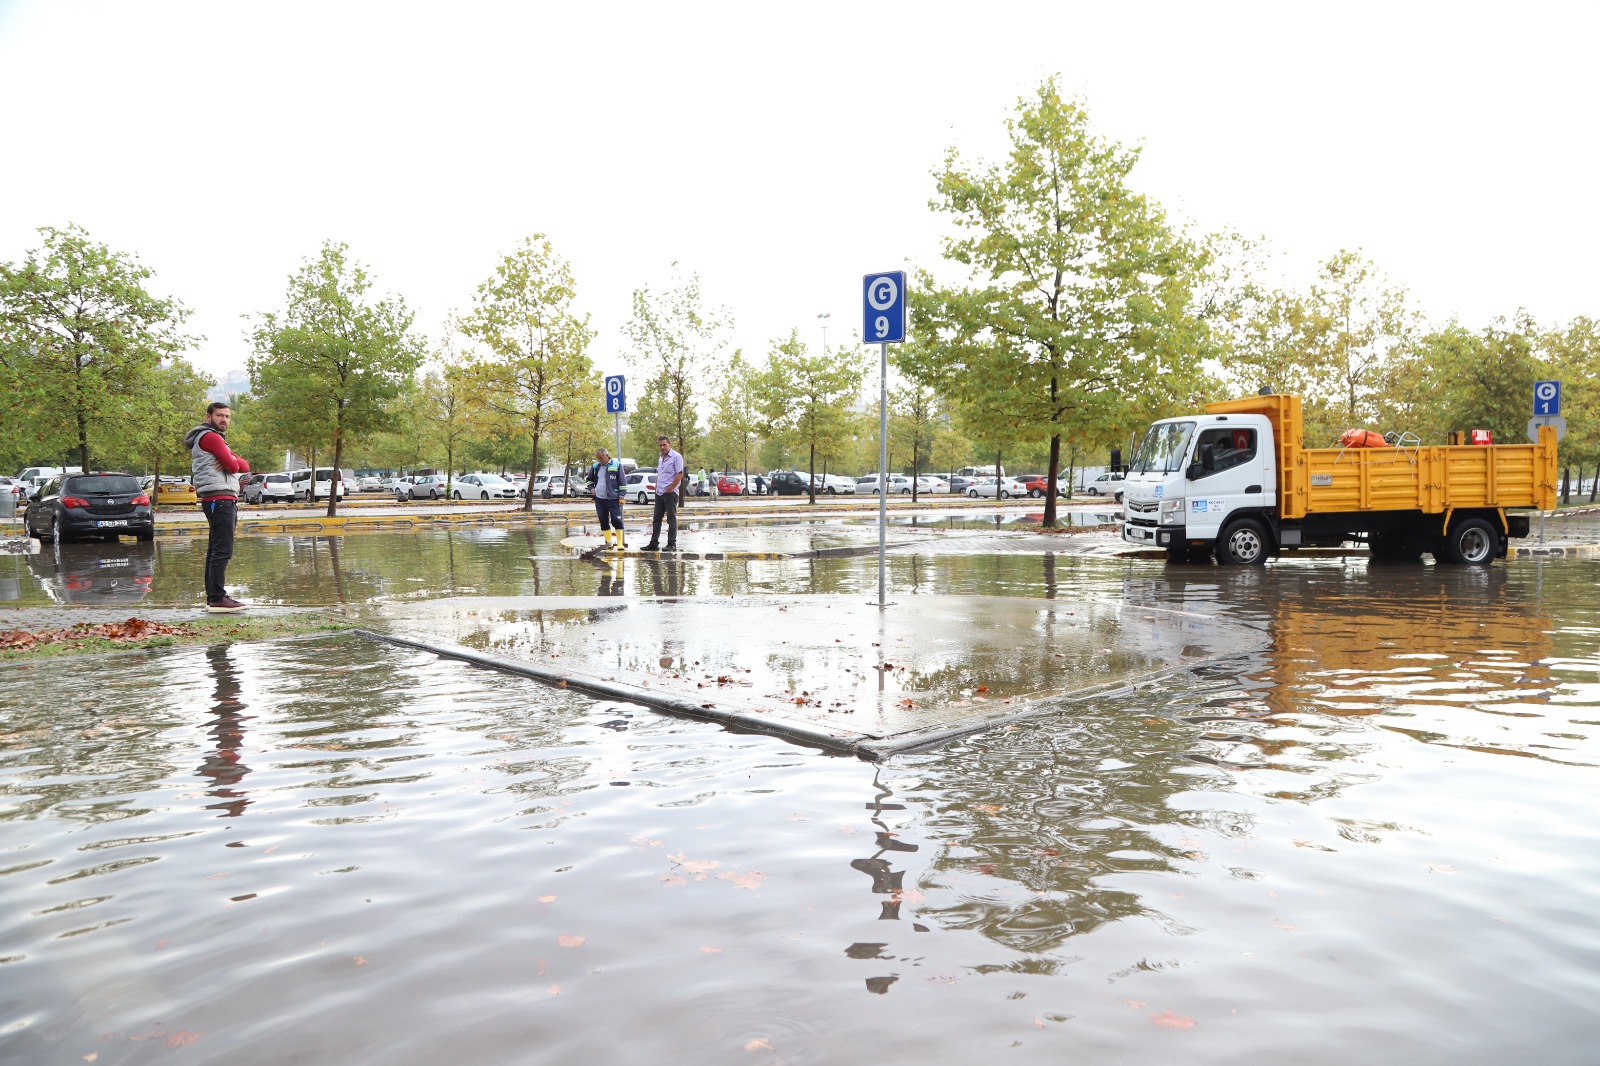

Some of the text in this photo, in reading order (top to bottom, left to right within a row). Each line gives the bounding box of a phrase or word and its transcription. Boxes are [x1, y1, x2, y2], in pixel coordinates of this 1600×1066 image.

[875, 315, 889, 338] 9
[612, 397, 620, 410] 8
[1541, 402, 1549, 413] 1
